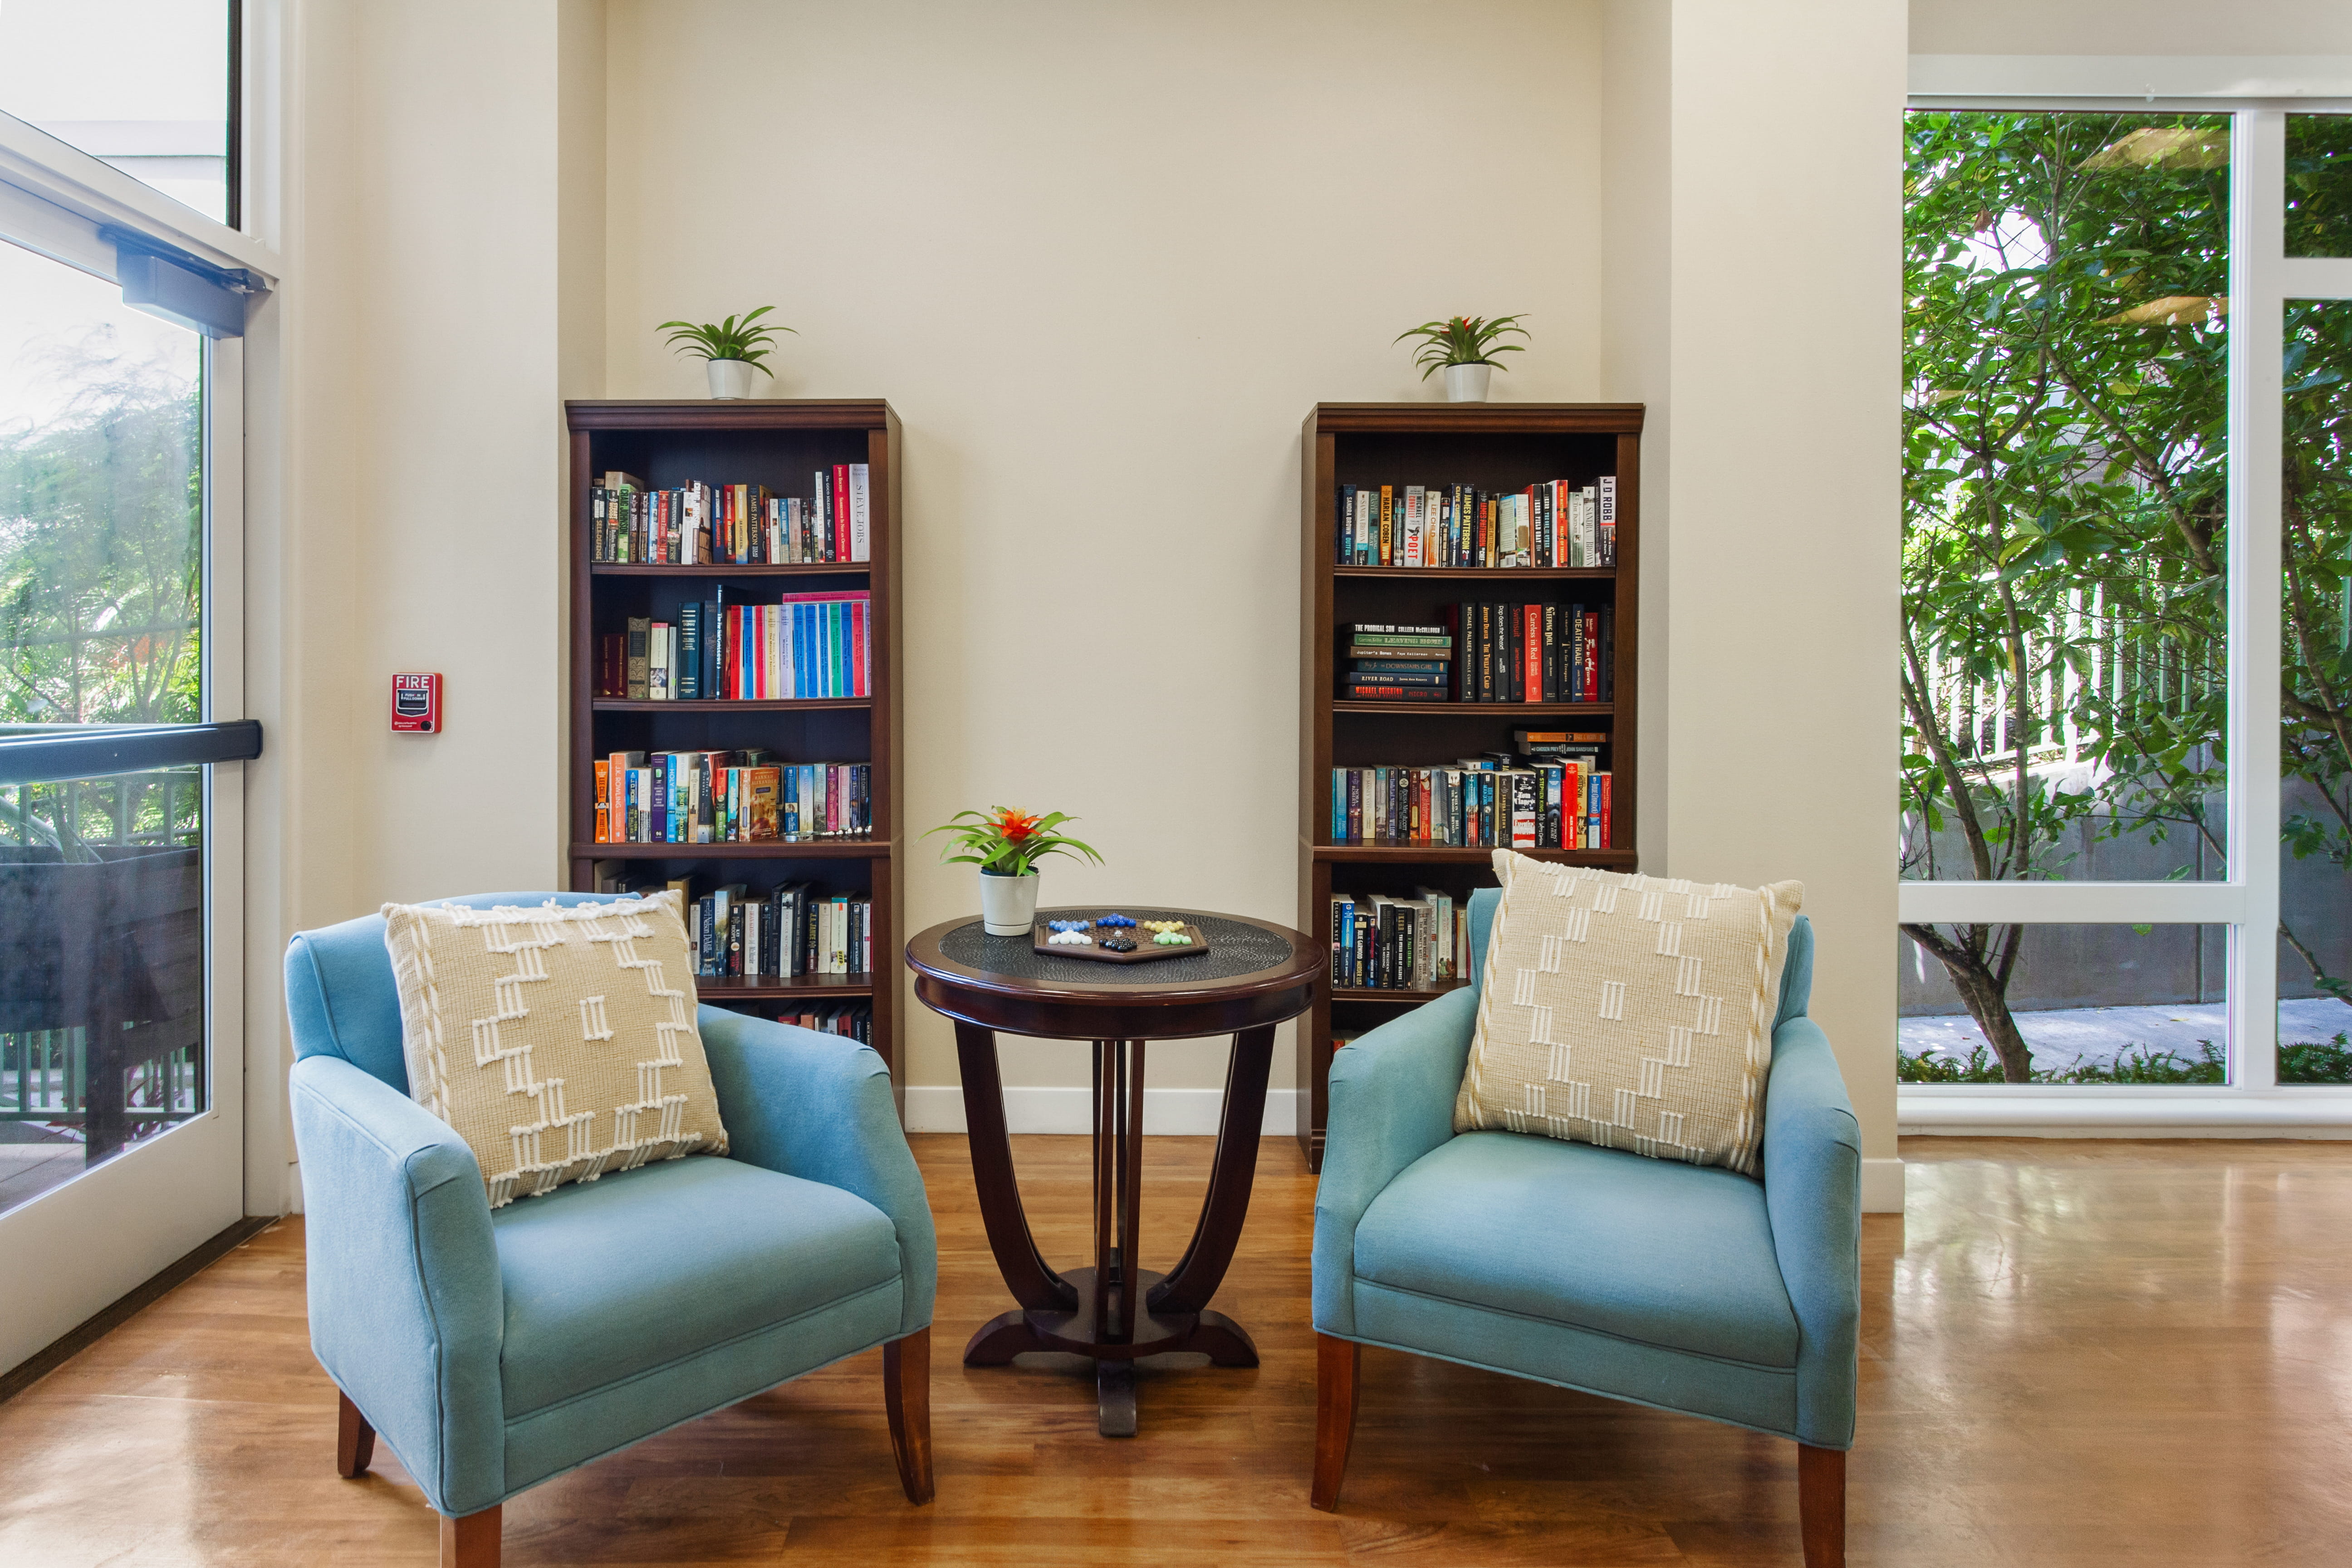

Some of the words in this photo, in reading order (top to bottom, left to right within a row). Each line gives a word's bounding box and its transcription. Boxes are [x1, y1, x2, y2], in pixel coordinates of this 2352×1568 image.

[620, 489, 628, 506] CRAIG
[620, 507, 628, 534] JOHNSON
[1408, 536, 1418, 559] POET
[1546, 607, 1554, 631] SLEEPING
[396, 676, 429, 689] FIRE
[703, 917, 712, 933] Nelson
[703, 935, 712, 953] DeMille
